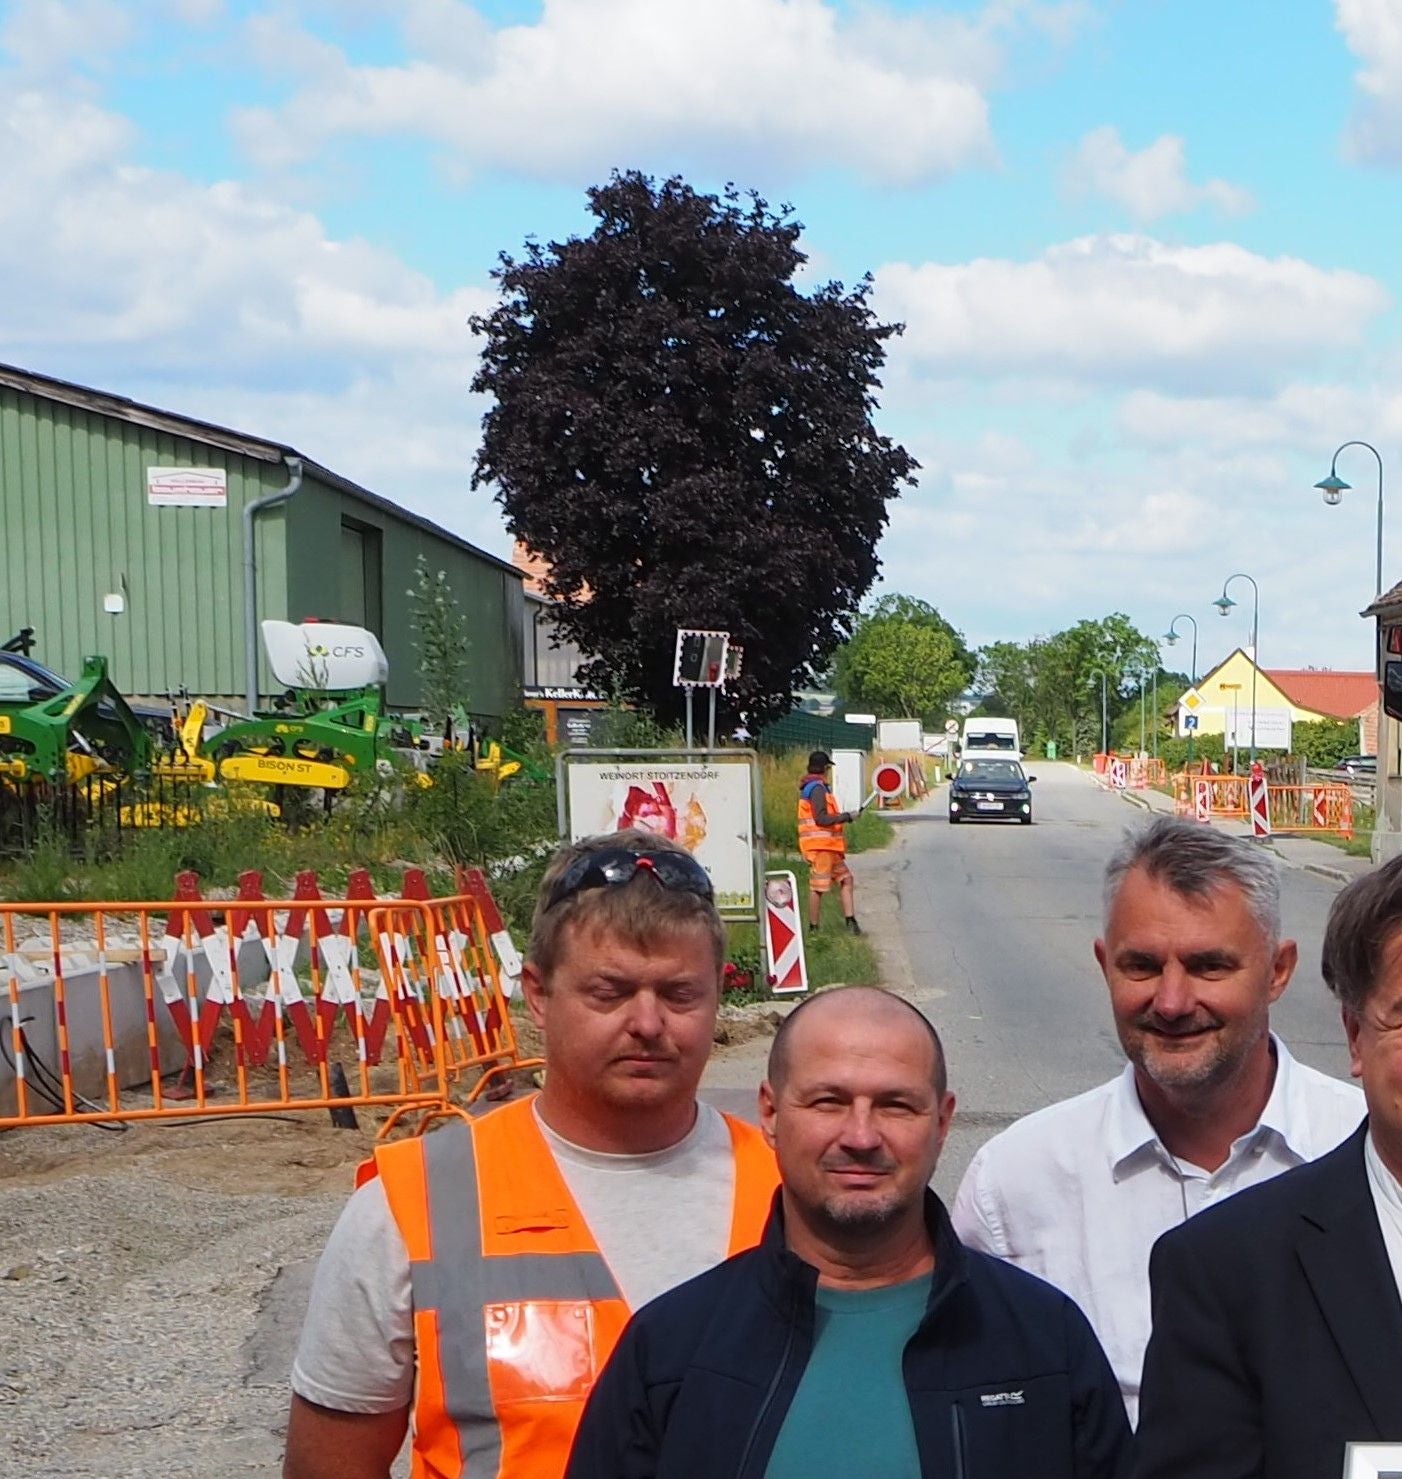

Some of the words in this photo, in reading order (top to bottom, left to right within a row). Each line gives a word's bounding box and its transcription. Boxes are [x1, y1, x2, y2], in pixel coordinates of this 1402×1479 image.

[333, 646, 365, 659] CFS
[258, 760, 296, 771] BISON
[297, 763, 313, 774] ST
[600, 772, 644, 780] WEINORT
[647, 771, 720, 780] STOITZENDORF
